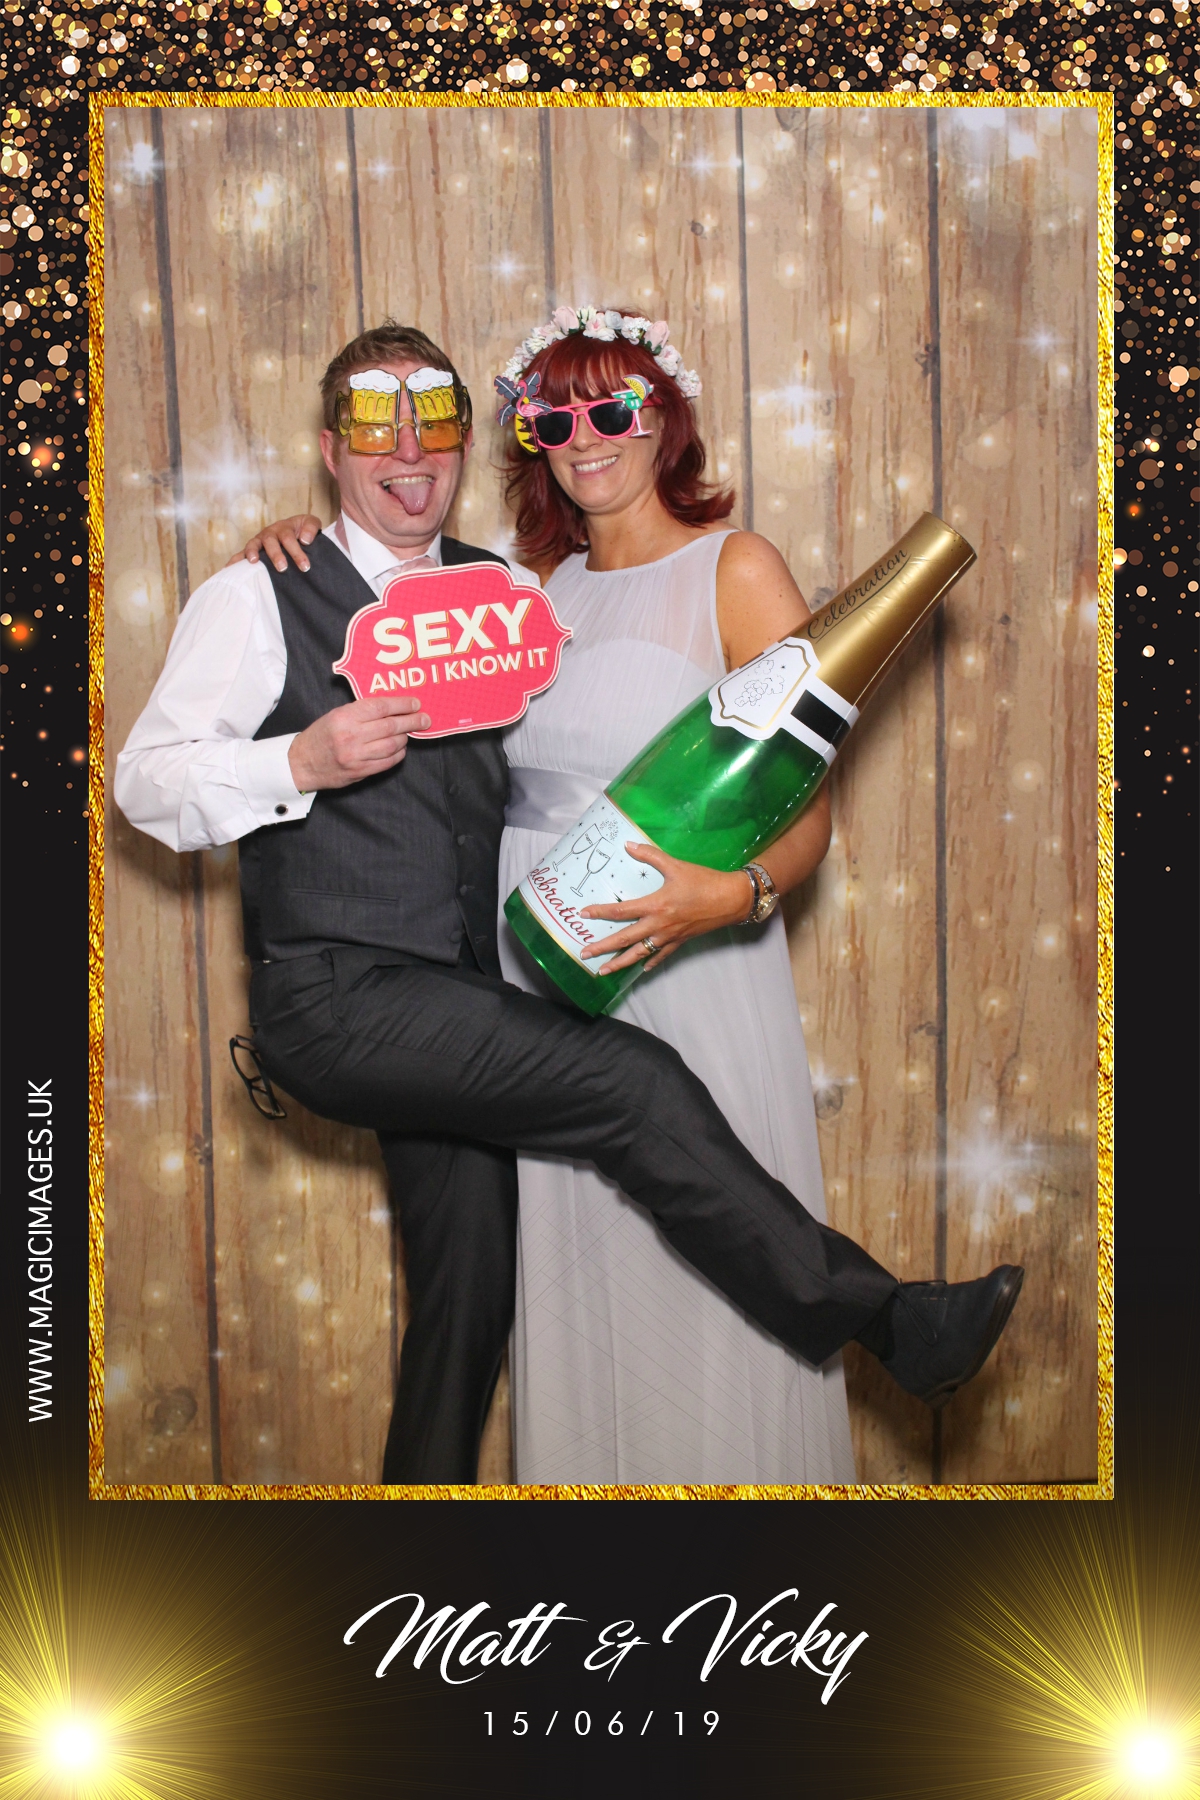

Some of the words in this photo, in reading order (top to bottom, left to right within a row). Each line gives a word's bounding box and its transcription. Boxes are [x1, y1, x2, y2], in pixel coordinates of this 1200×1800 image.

[372, 598, 534, 665] SEXY
[807, 549, 909, 641] Celebration
[369, 667, 426, 694] AND
[431, 664, 440, 684] I
[444, 651, 523, 682] KNOW
[527, 647, 549, 669] IT
[529, 857, 595, 944] elebration
